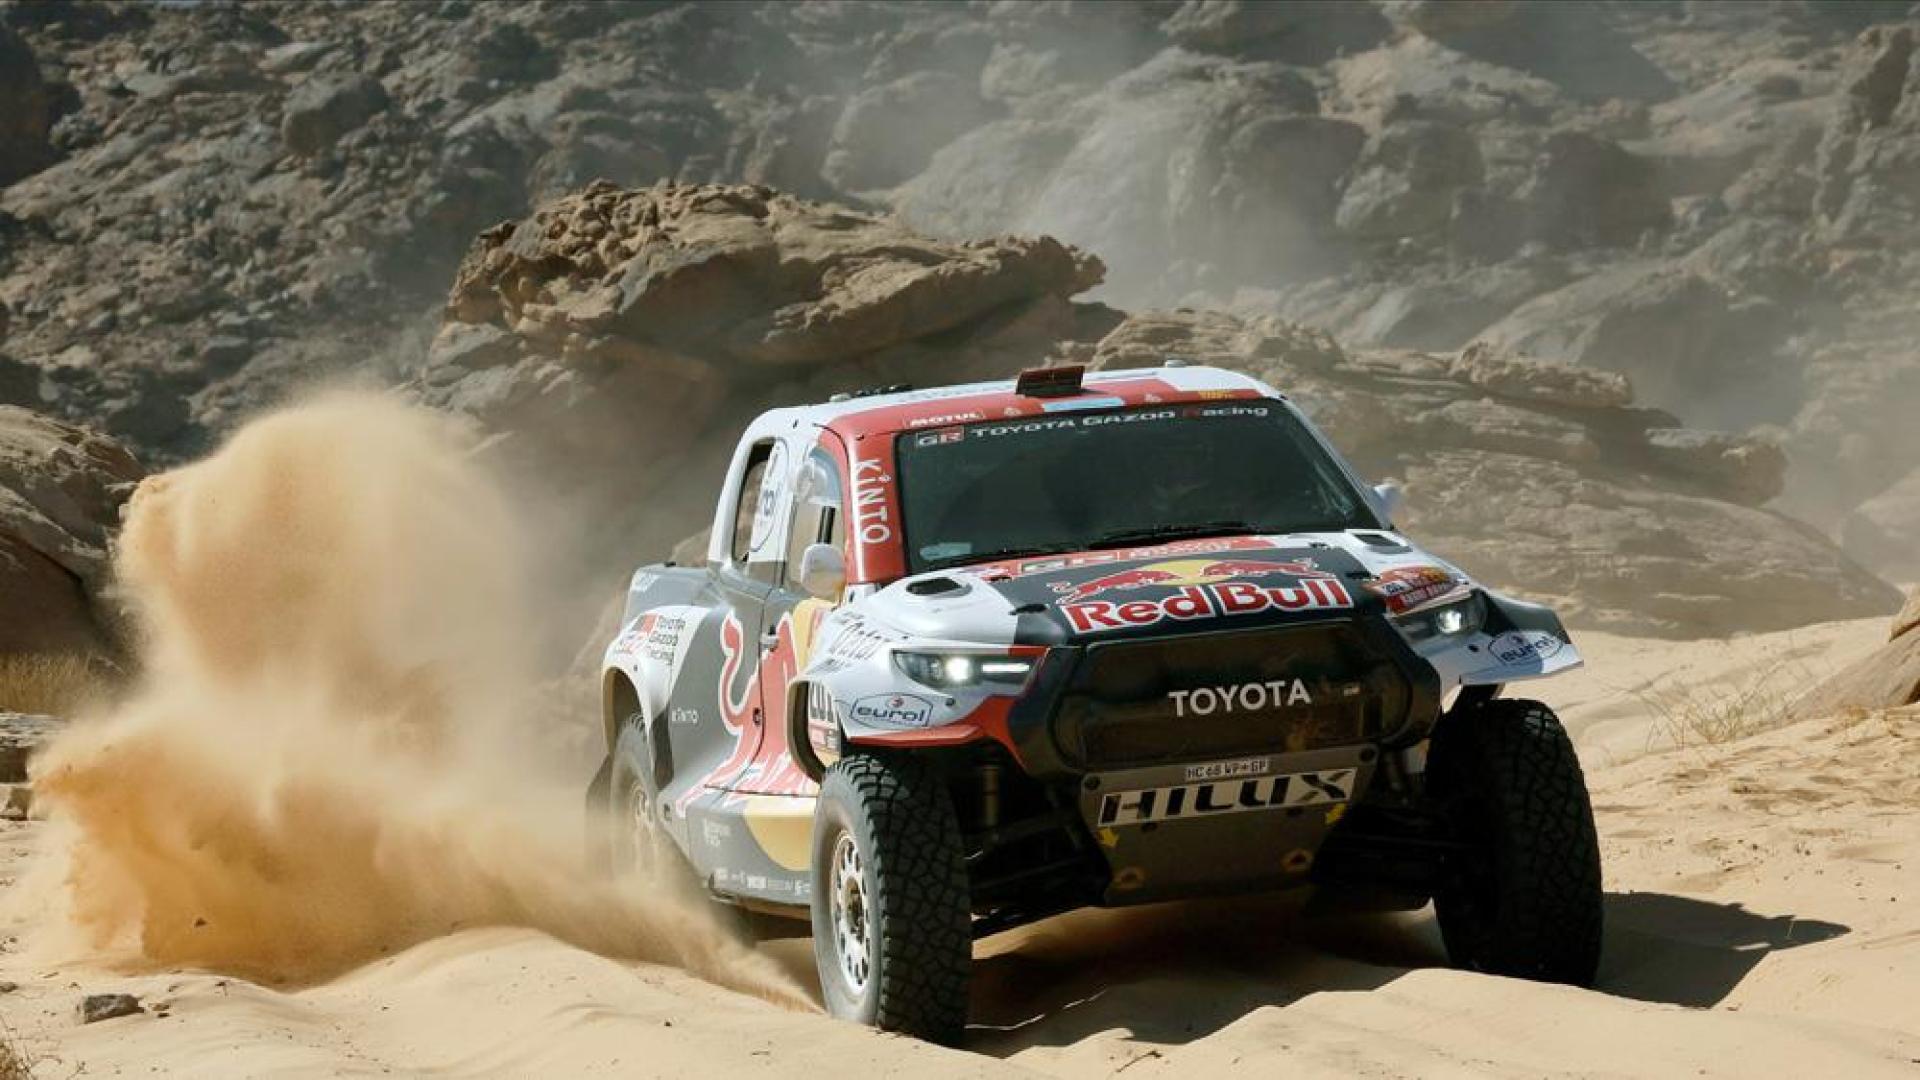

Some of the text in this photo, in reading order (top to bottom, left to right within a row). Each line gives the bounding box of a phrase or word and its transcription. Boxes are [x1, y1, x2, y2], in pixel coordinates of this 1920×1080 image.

[911, 412, 979, 427] MOTUL
[971, 419, 1076, 438] TOYOTA
[1082, 410, 1176, 426] GAZOO
[1064, 584, 1214, 633] Red
[1216, 578, 1353, 615] Bull
[857, 706, 926, 722] eurol
[1168, 678, 1312, 718] TOYOTA
[1101, 770, 1353, 823] HILUX
